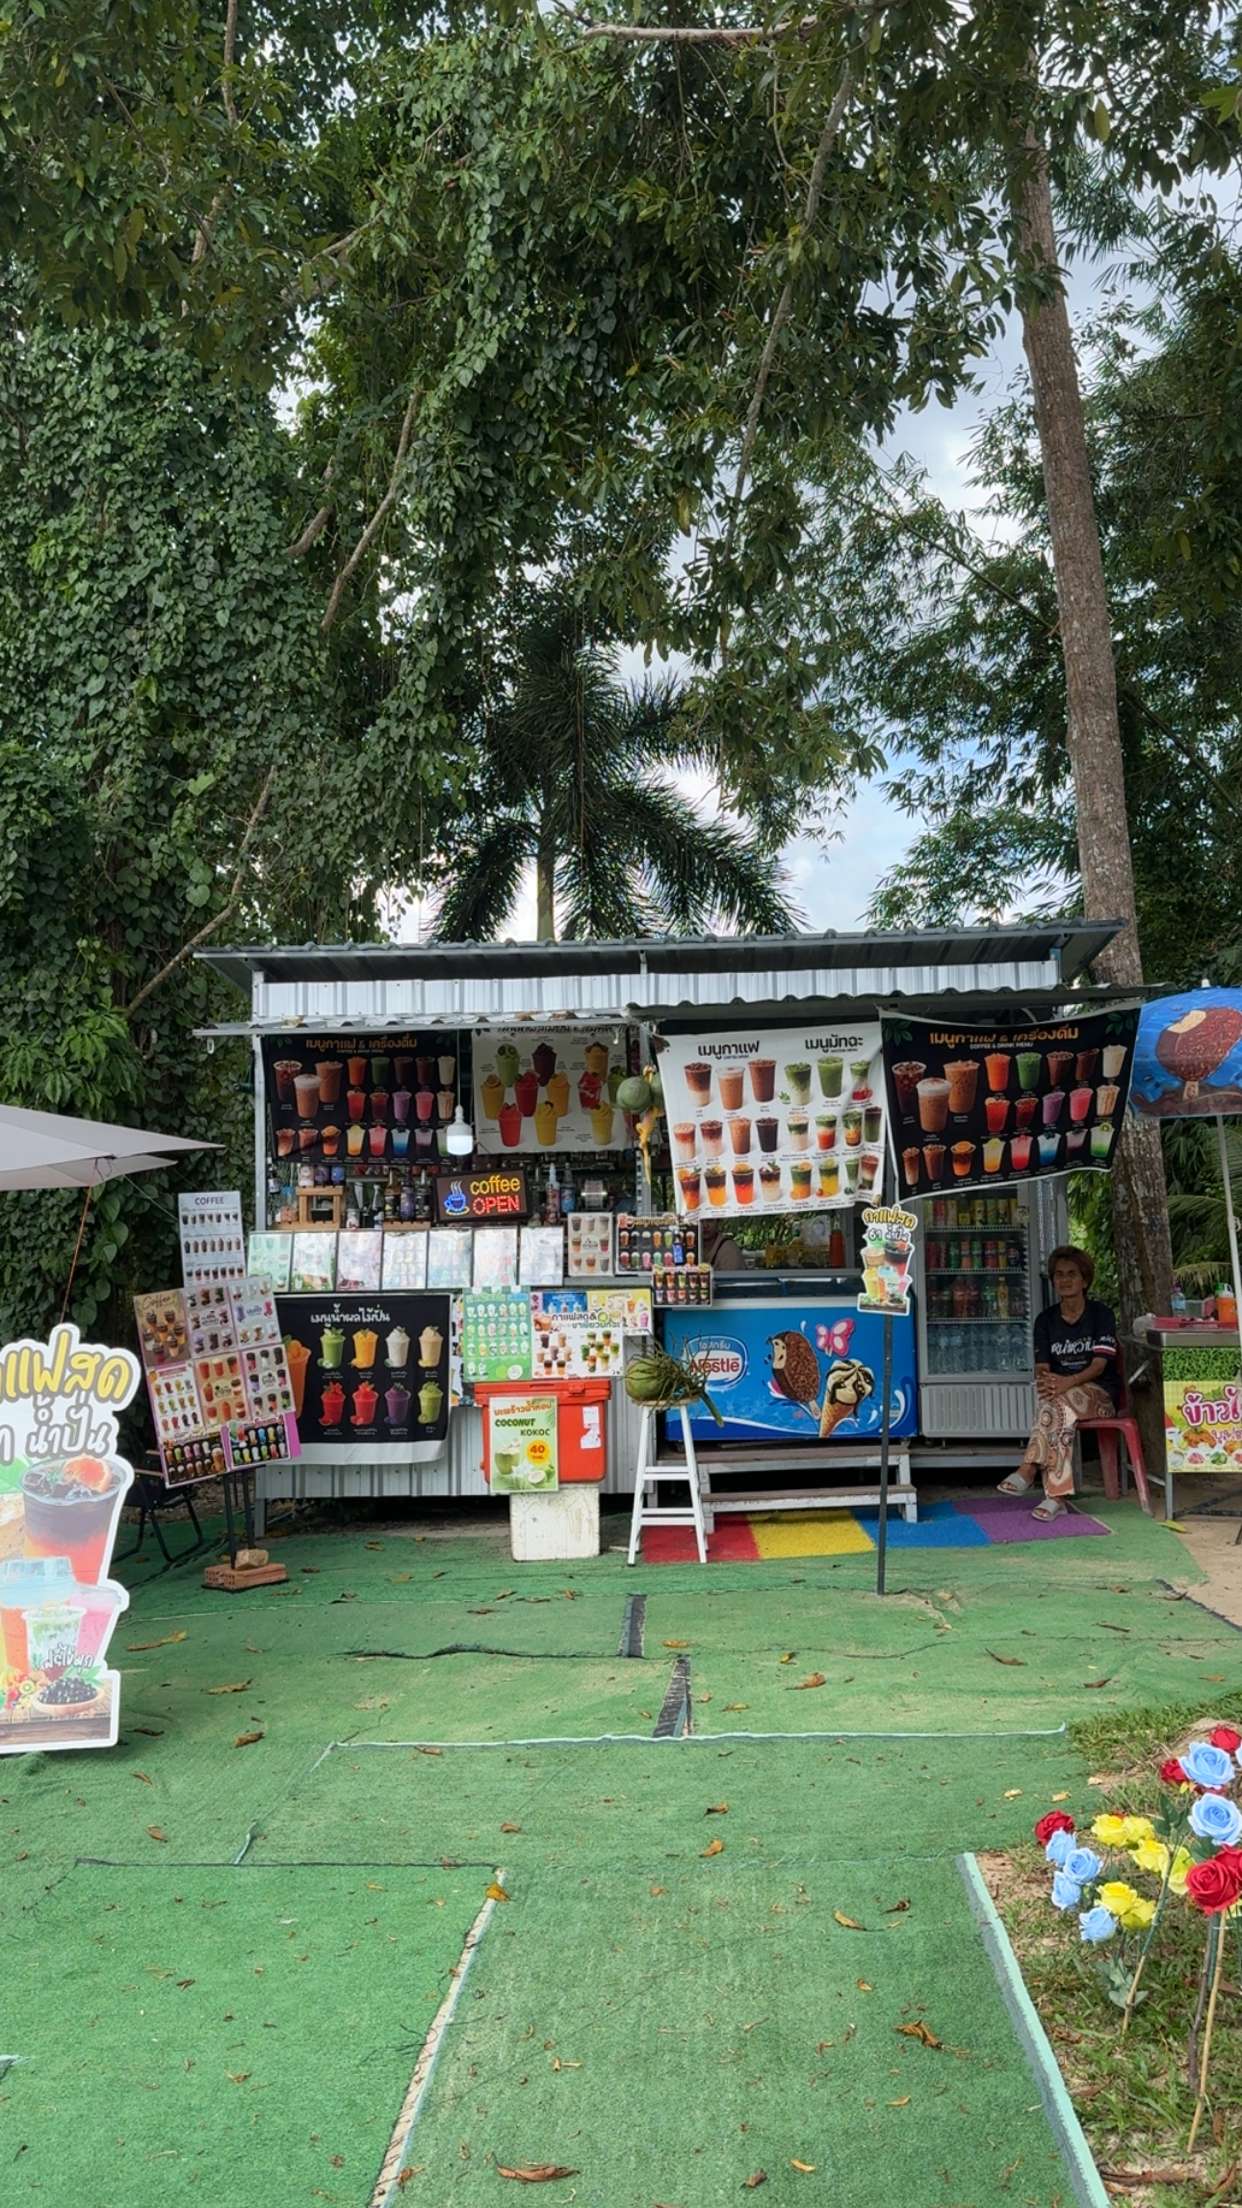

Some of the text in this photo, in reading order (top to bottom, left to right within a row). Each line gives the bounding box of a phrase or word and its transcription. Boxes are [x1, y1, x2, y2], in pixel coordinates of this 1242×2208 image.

[698, 1039, 760, 1059] เมนูกาแฟ
[805, 1034, 864, 1053] เมนูมัทฉะ
[470, 1174, 521, 1195] coffee
[194, 1196, 225, 1206] COFFEE
[472, 1195, 520, 1215] OPEN
[0, 1329, 134, 1404] แฟสด
[495, 1418, 536, 1427] COCONUT
[530, 1444, 545, 1454] 40
